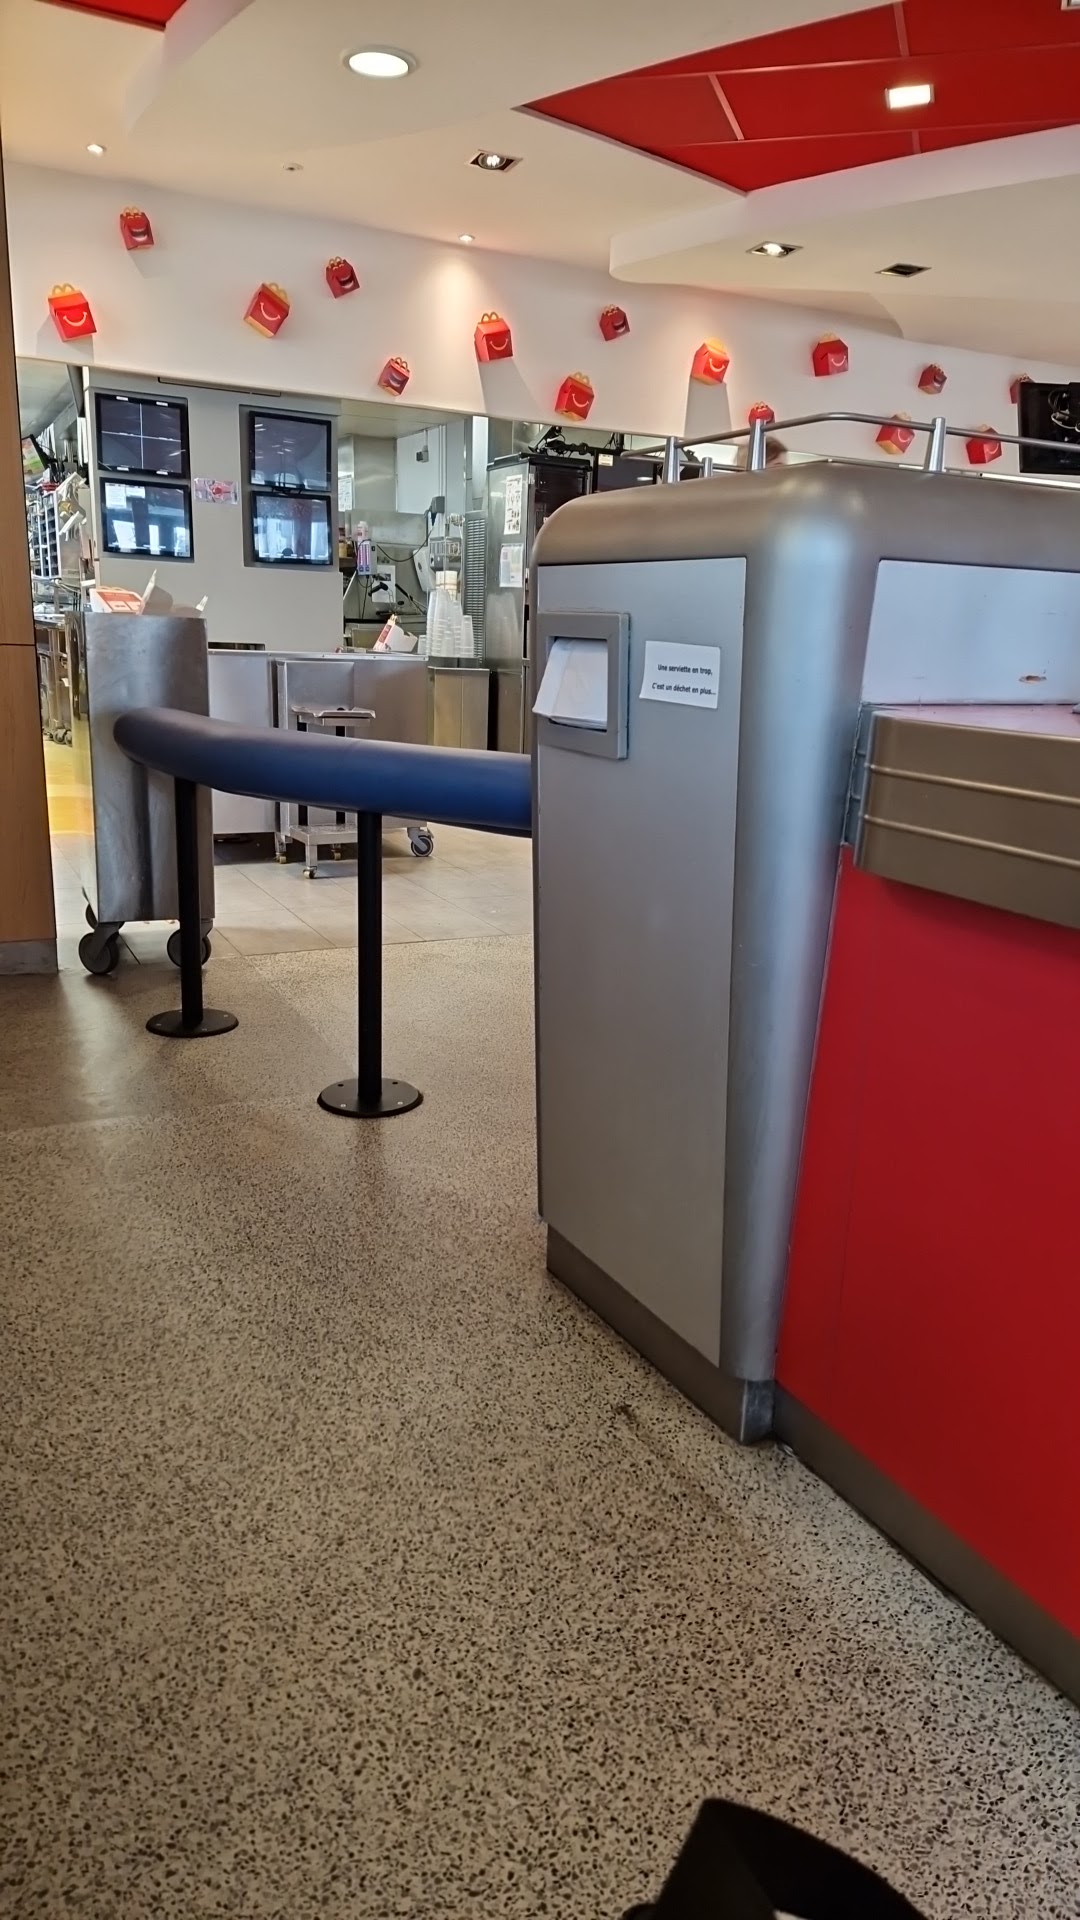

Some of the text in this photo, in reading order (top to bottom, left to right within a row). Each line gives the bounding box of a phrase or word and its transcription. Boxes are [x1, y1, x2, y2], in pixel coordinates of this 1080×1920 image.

[668, 665, 690, 673] serviette
[700, 667, 712, 676] trop,
[652, 682, 664, 690] C'est
[673, 684, 690, 692] déchet
